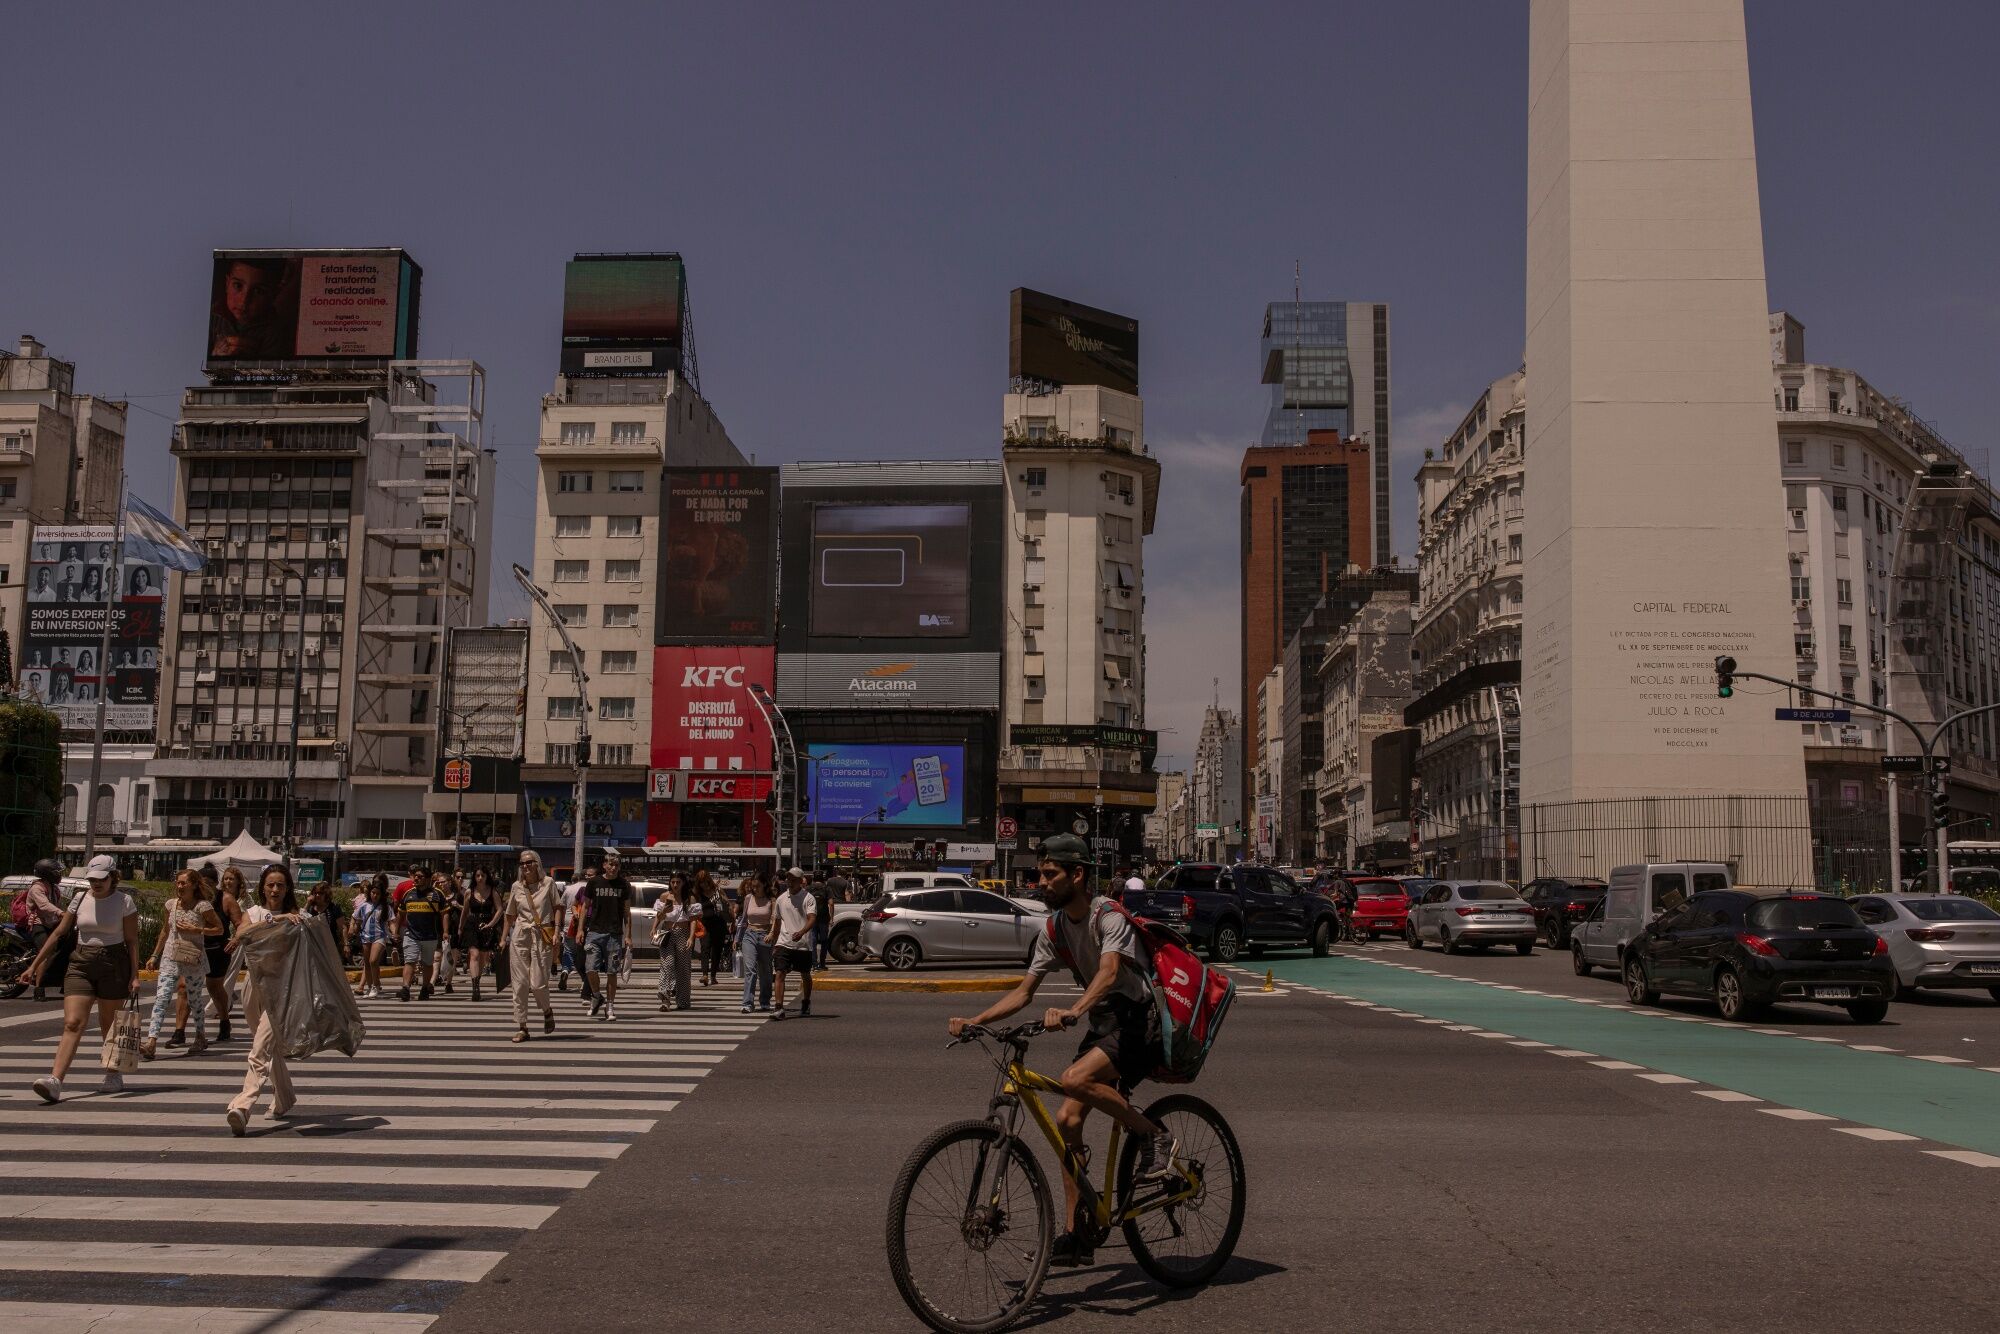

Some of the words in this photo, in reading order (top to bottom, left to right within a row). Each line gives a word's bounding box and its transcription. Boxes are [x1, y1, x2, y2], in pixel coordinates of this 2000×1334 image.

[320, 264, 344, 273] Estas
[346, 264, 379, 274] fiestas,
[325, 274, 376, 283] transformá
[324, 286, 376, 294] realidades
[310, 297, 354, 306] donando
[357, 297, 388, 306] online.
[594, 356, 621, 364] BRAND
[624, 355, 642, 363] PLUS
[686, 498, 698, 509] DE
[700, 498, 726, 509] NADA
[728, 498, 748, 509] POR
[694, 511, 704, 522] EL
[707, 511, 741, 522] PRECIO
[1633, 602, 1676, 613] CAPITAL
[1683, 602, 1731, 613] FEDERAL
[32, 609, 69, 619] SOMOS
[919, 614, 940, 626] BA
[31, 621, 45, 630] EN
[730, 620, 757, 631] KFC
[681, 666, 746, 687] KFC
[1630, 675, 1674, 685] NICOLAS
[1680, 675, 1738, 685] AVELLAA
[848, 678, 916, 690] Atacama
[689, 699, 735, 715] DISFRUTÁ
[1648, 706, 1677, 716] JULIO
[1683, 706, 1689, 716] A
[1694, 706, 1725, 716] ROCA
[680, 716, 689, 727] EL
[691, 716, 717, 727] MEJOR
[719, 716, 743, 727] POLLO
[689, 729, 703, 740] DEL
[705, 729, 734, 740] MUNDO
[916, 761, 938, 772] 20%
[832, 769, 870, 777] personal
[871, 769, 888, 777] pay
[691, 779, 736, 794] KFC
[834, 780, 871, 788] conviene!
[1049, 792, 1076, 800] TOSTADO
